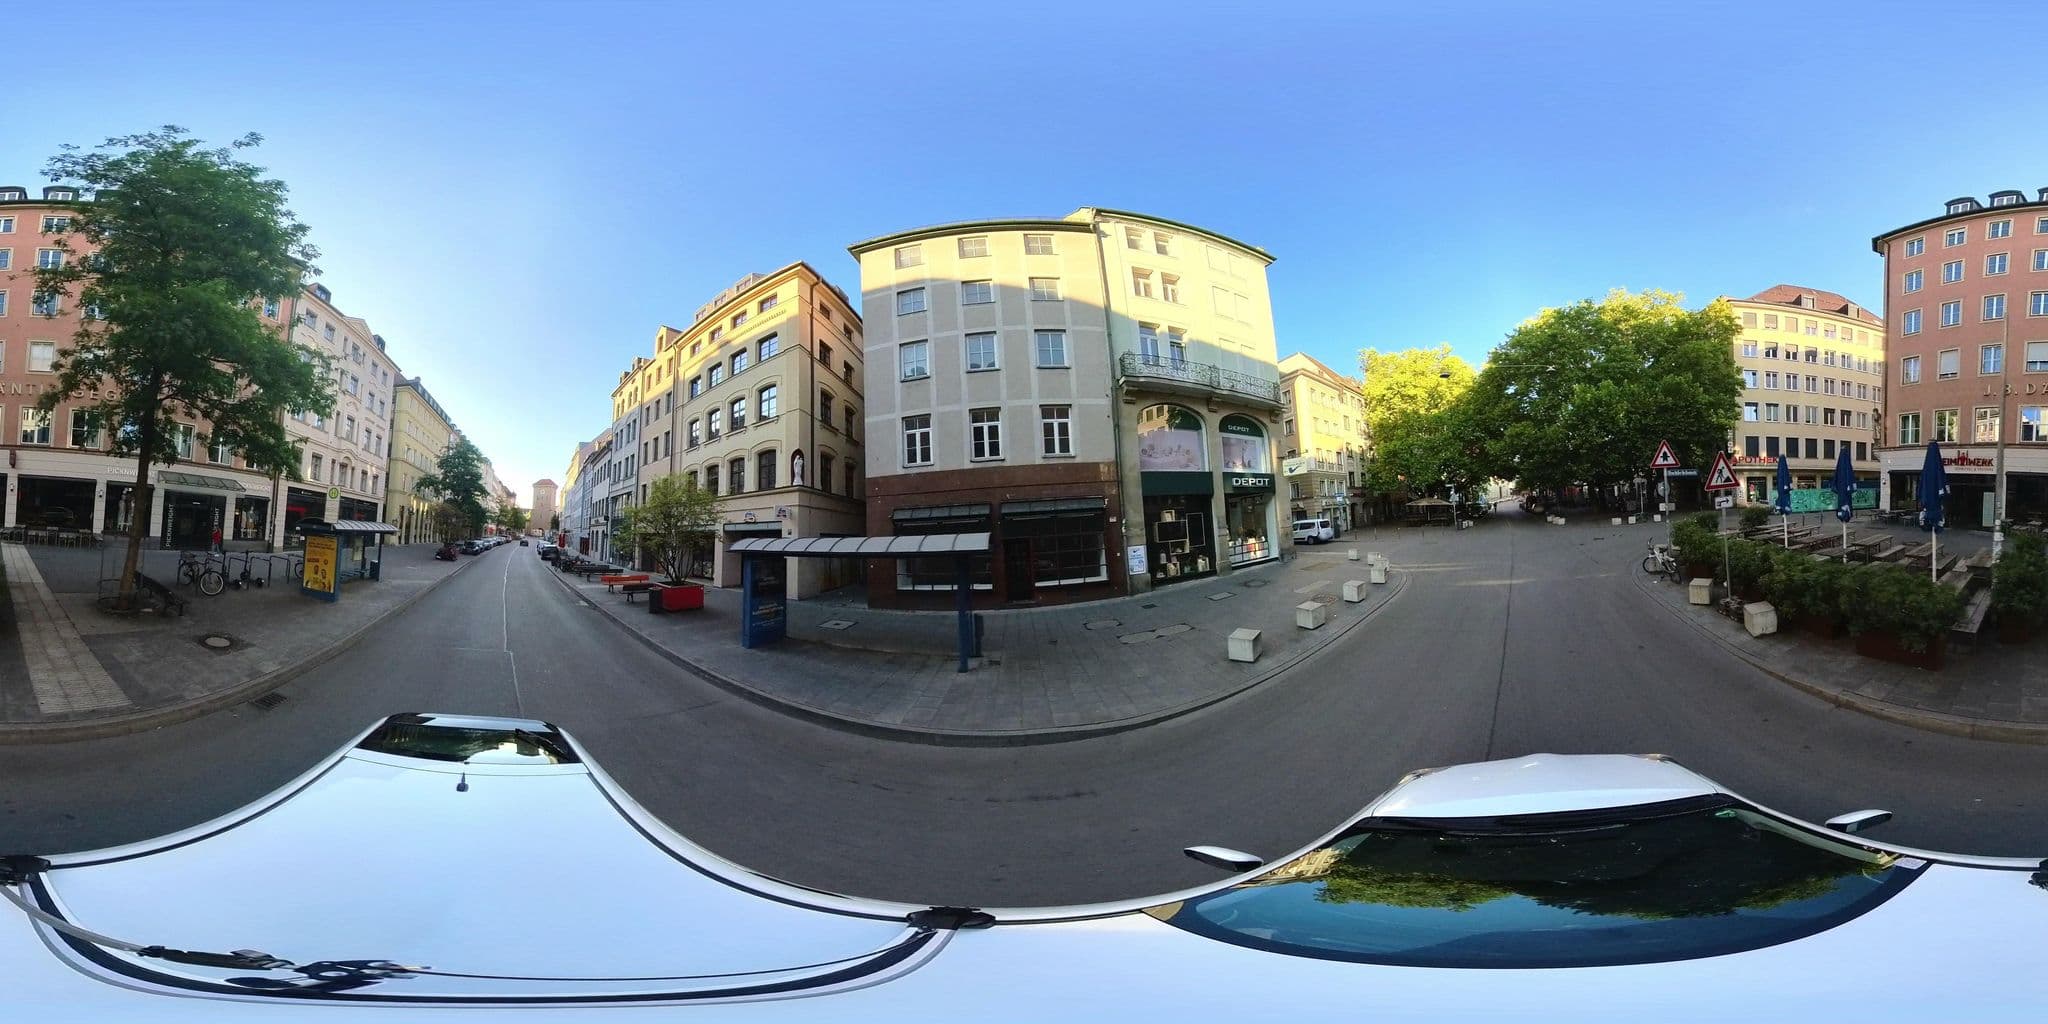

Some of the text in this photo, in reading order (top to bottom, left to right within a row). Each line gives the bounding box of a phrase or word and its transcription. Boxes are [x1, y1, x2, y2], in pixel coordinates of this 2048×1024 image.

[1227, 424, 1249, 432] DEPOT
[1730, 455, 1778, 465] APOTHEK
[1232, 477, 1270, 487] DEPOT
[165, 503, 176, 547] PICKNWEIGHT
